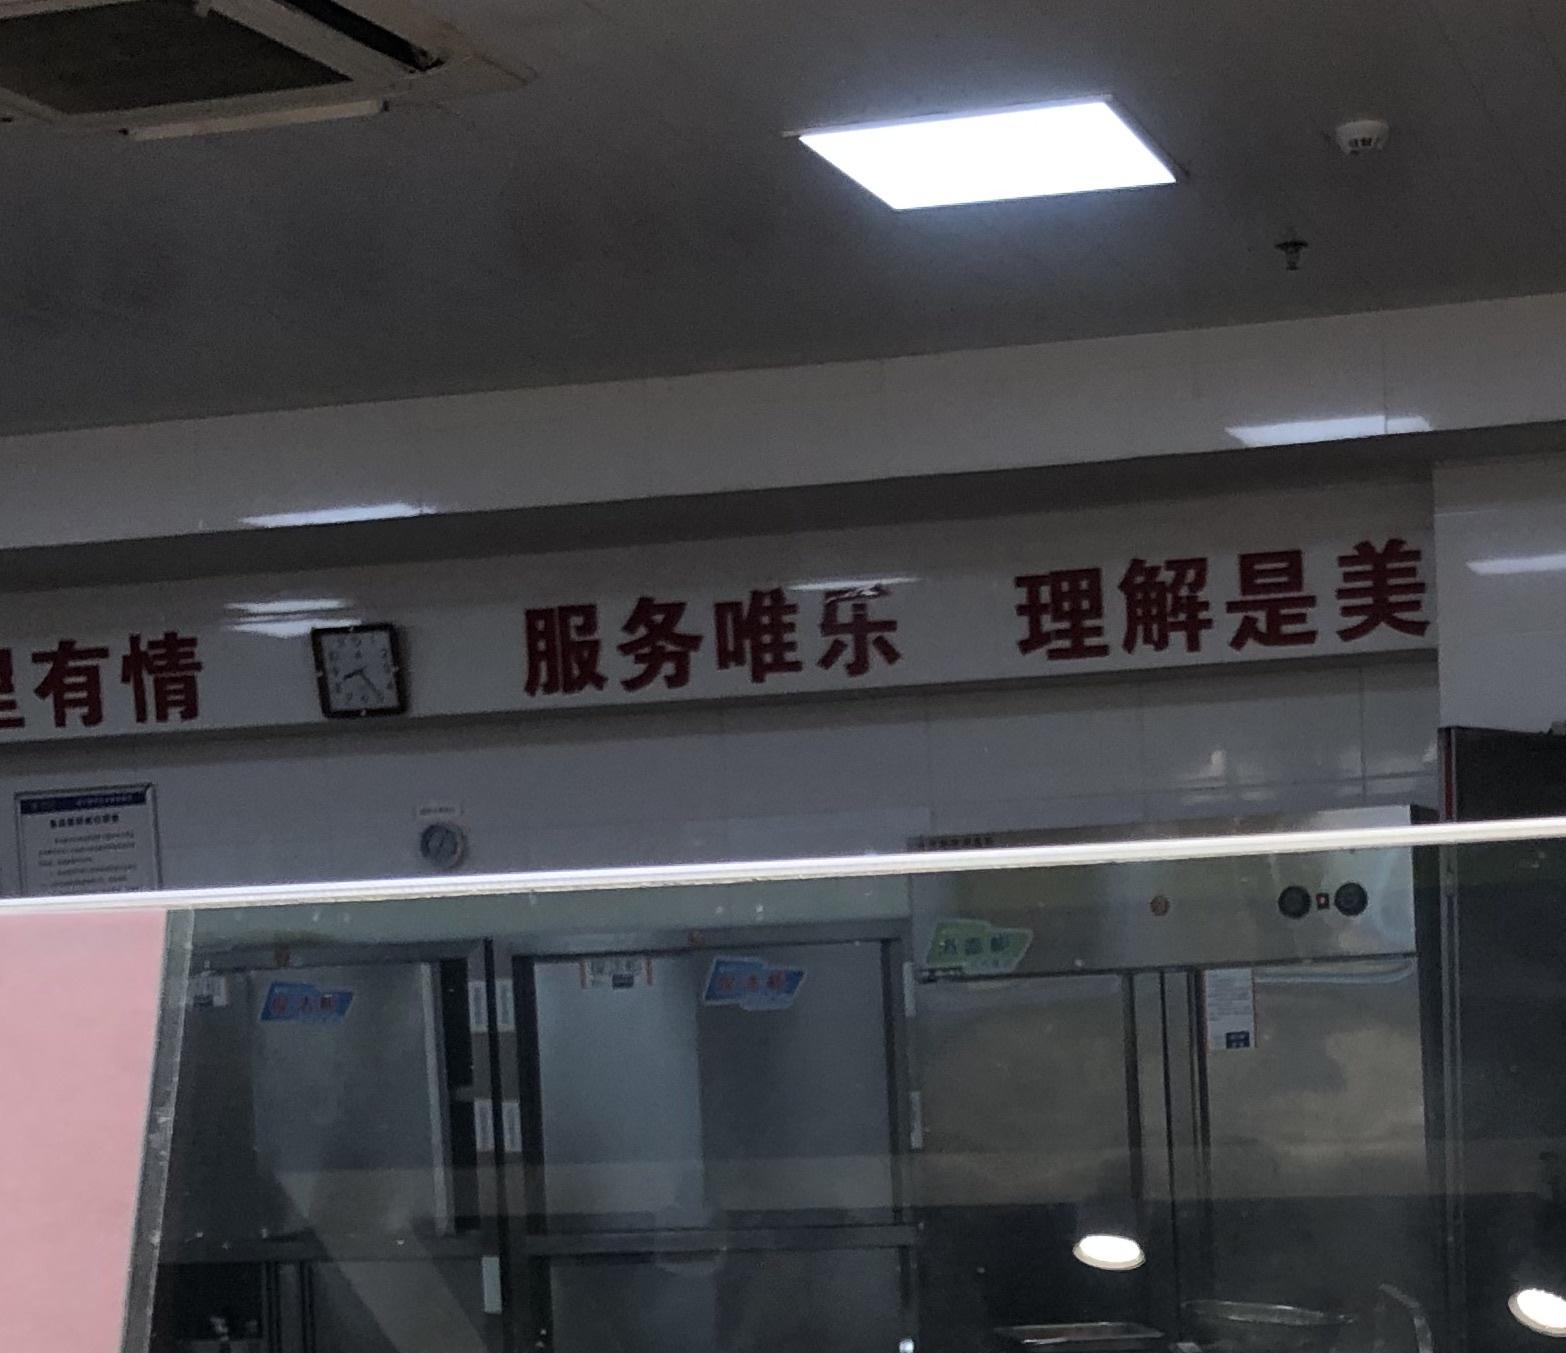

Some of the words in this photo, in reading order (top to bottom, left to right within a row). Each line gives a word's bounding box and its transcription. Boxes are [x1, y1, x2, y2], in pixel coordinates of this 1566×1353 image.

[524, 588, 900, 696] 服务唯乐
[1014, 539, 1430, 662] 理解是美
